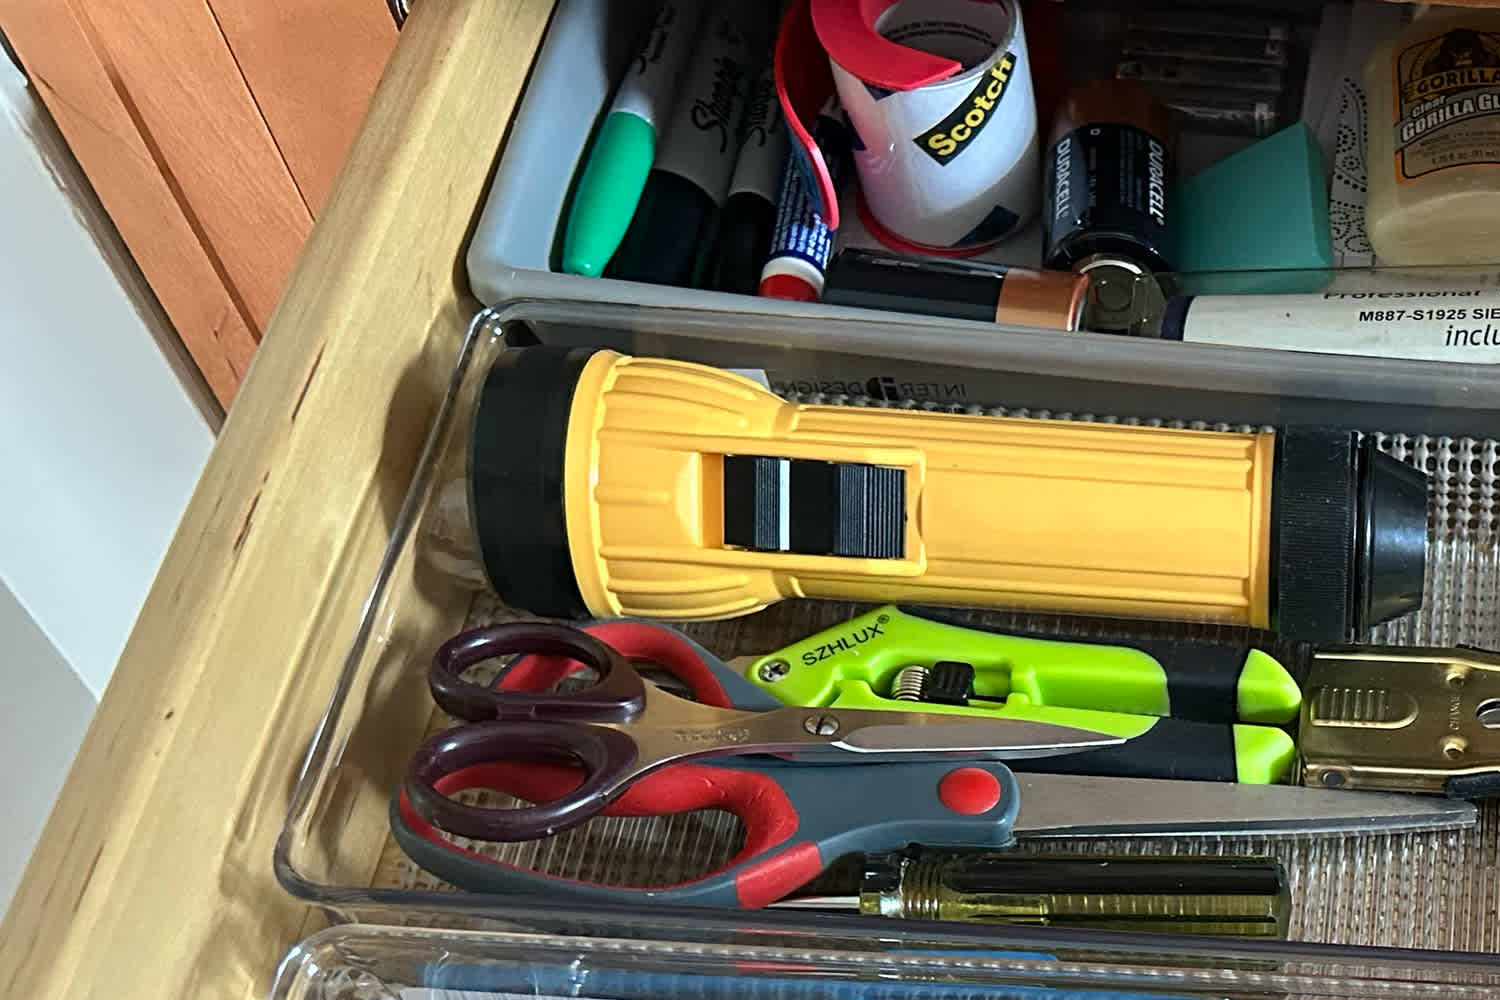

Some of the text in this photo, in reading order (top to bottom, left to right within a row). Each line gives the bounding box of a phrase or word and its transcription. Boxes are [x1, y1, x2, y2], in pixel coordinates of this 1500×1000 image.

[927, 57, 1013, 156] Scotch
[1402, 100, 1474, 142] GORILLA
[1411, 95, 1447, 118] Clear
[1055, 138, 1071, 220] DURACELL
[1148, 139, 1164, 219] DURACELL
[1358, 308, 1468, 323] M887-S1925
[801, 623, 885, 666] SZHLUX
